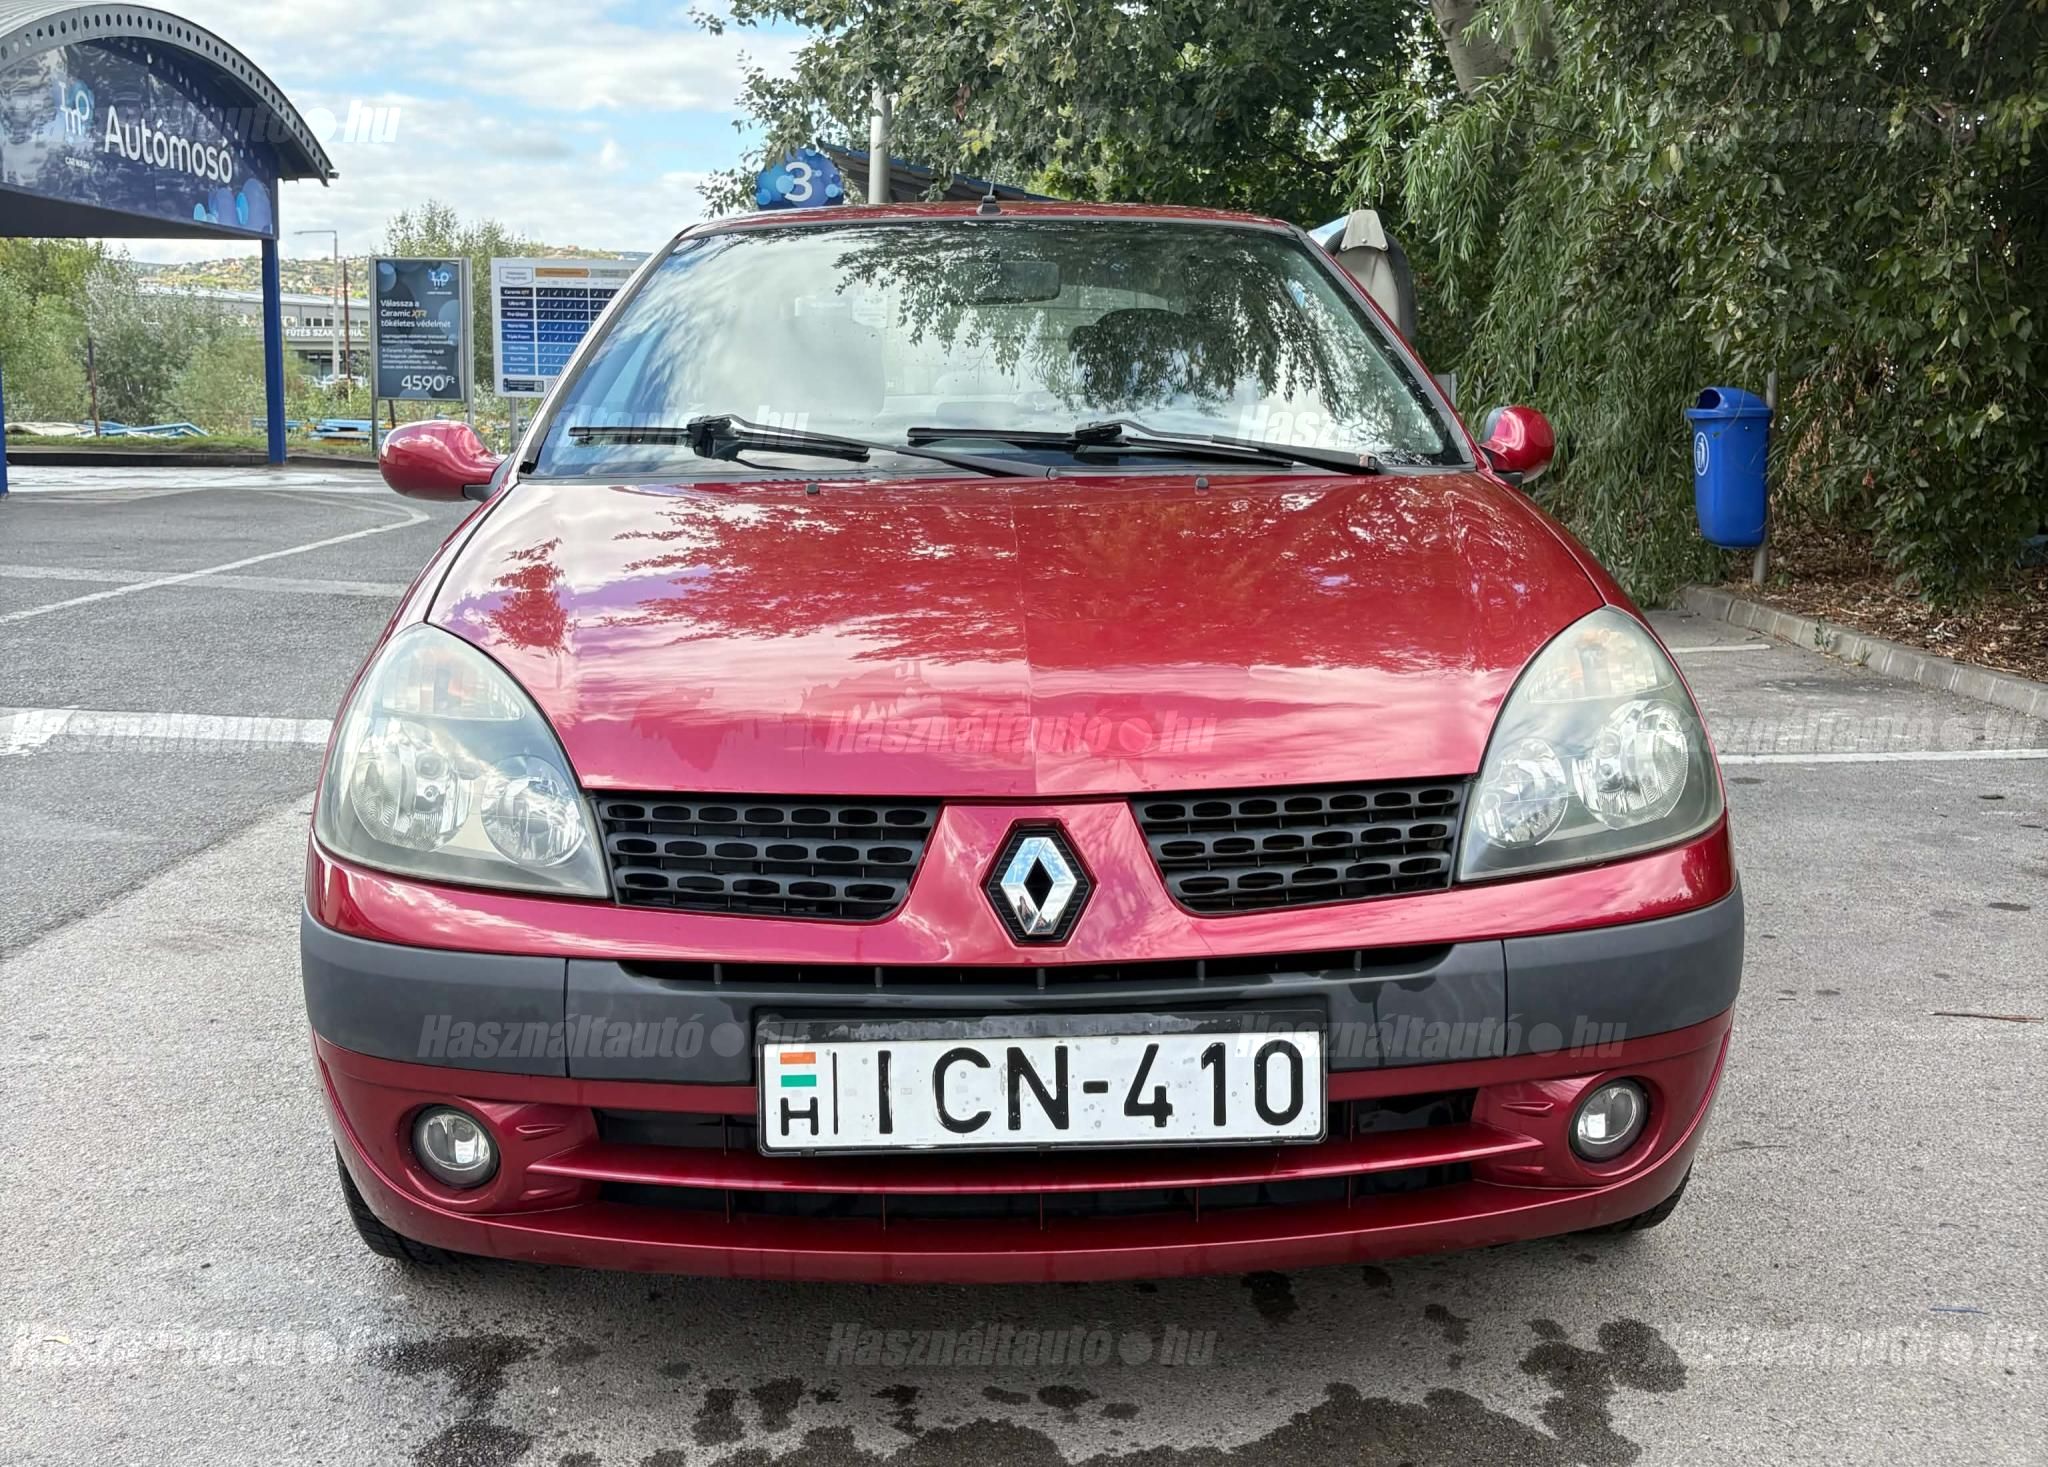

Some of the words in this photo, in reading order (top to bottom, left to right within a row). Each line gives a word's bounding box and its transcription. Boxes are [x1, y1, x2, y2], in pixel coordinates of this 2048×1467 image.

[104, 104, 233, 185] Autómosó
[784, 161, 813, 202] 3
[380, 300, 413, 308] Válassza
[380, 309, 410, 317] Ceramic
[401, 375, 445, 391] 4590
[780, 1096, 819, 1136] H
[878, 1040, 1304, 1135] ICN-410
